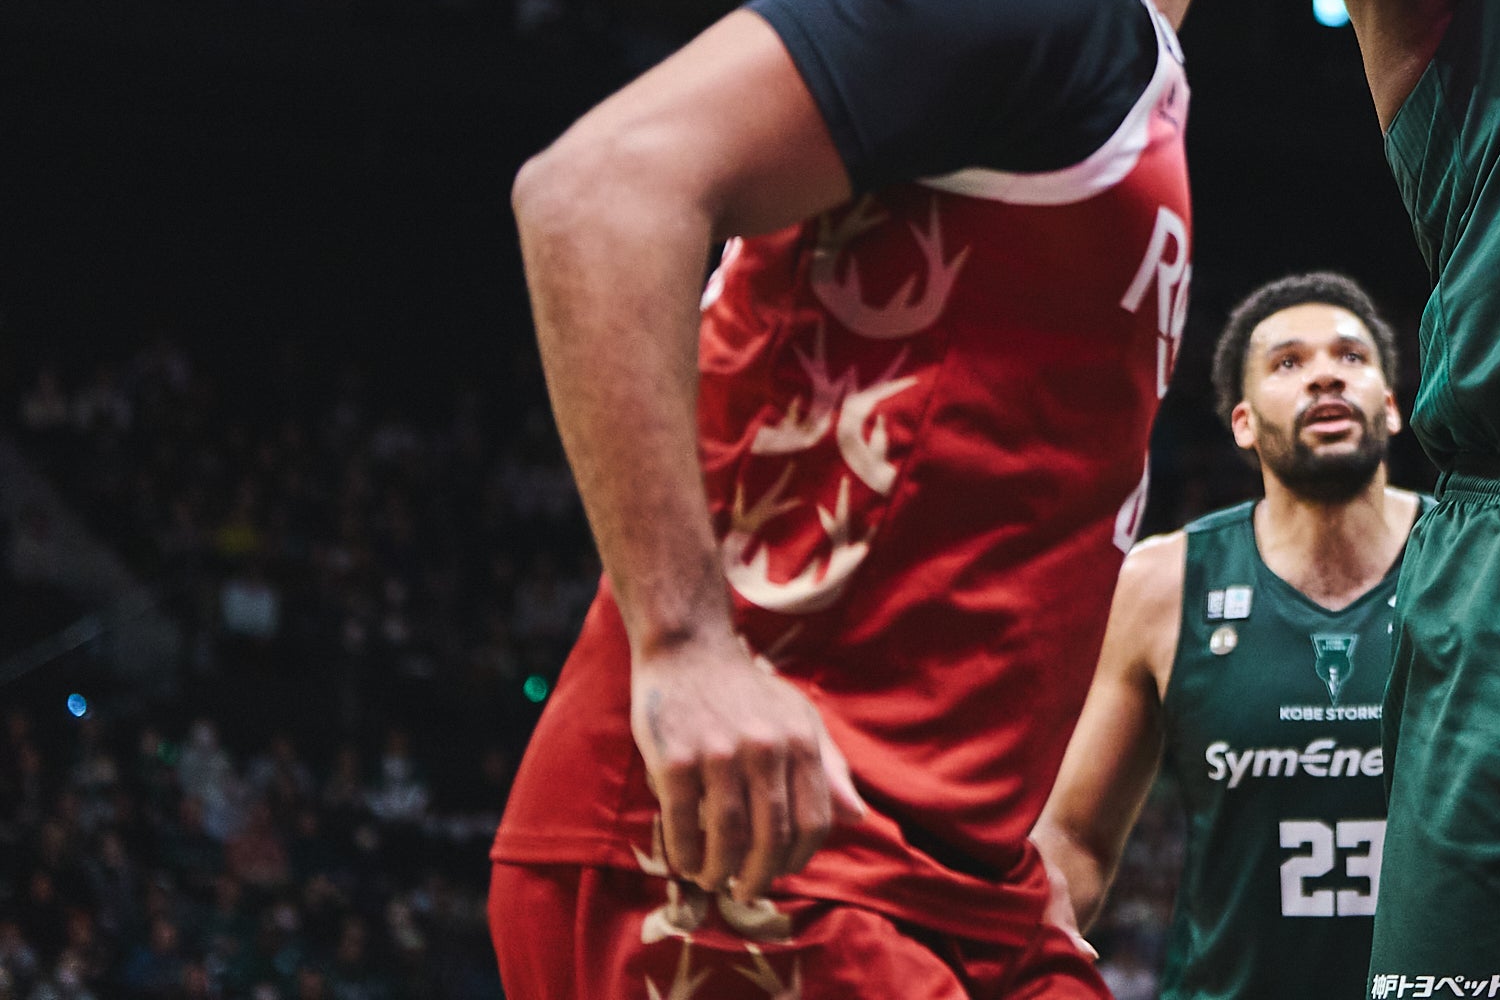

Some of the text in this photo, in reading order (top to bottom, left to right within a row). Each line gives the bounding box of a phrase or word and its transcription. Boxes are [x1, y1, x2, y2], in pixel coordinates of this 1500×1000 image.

[1279, 705, 1383, 721] KOBE STORK
[1279, 819, 1388, 917] 23
